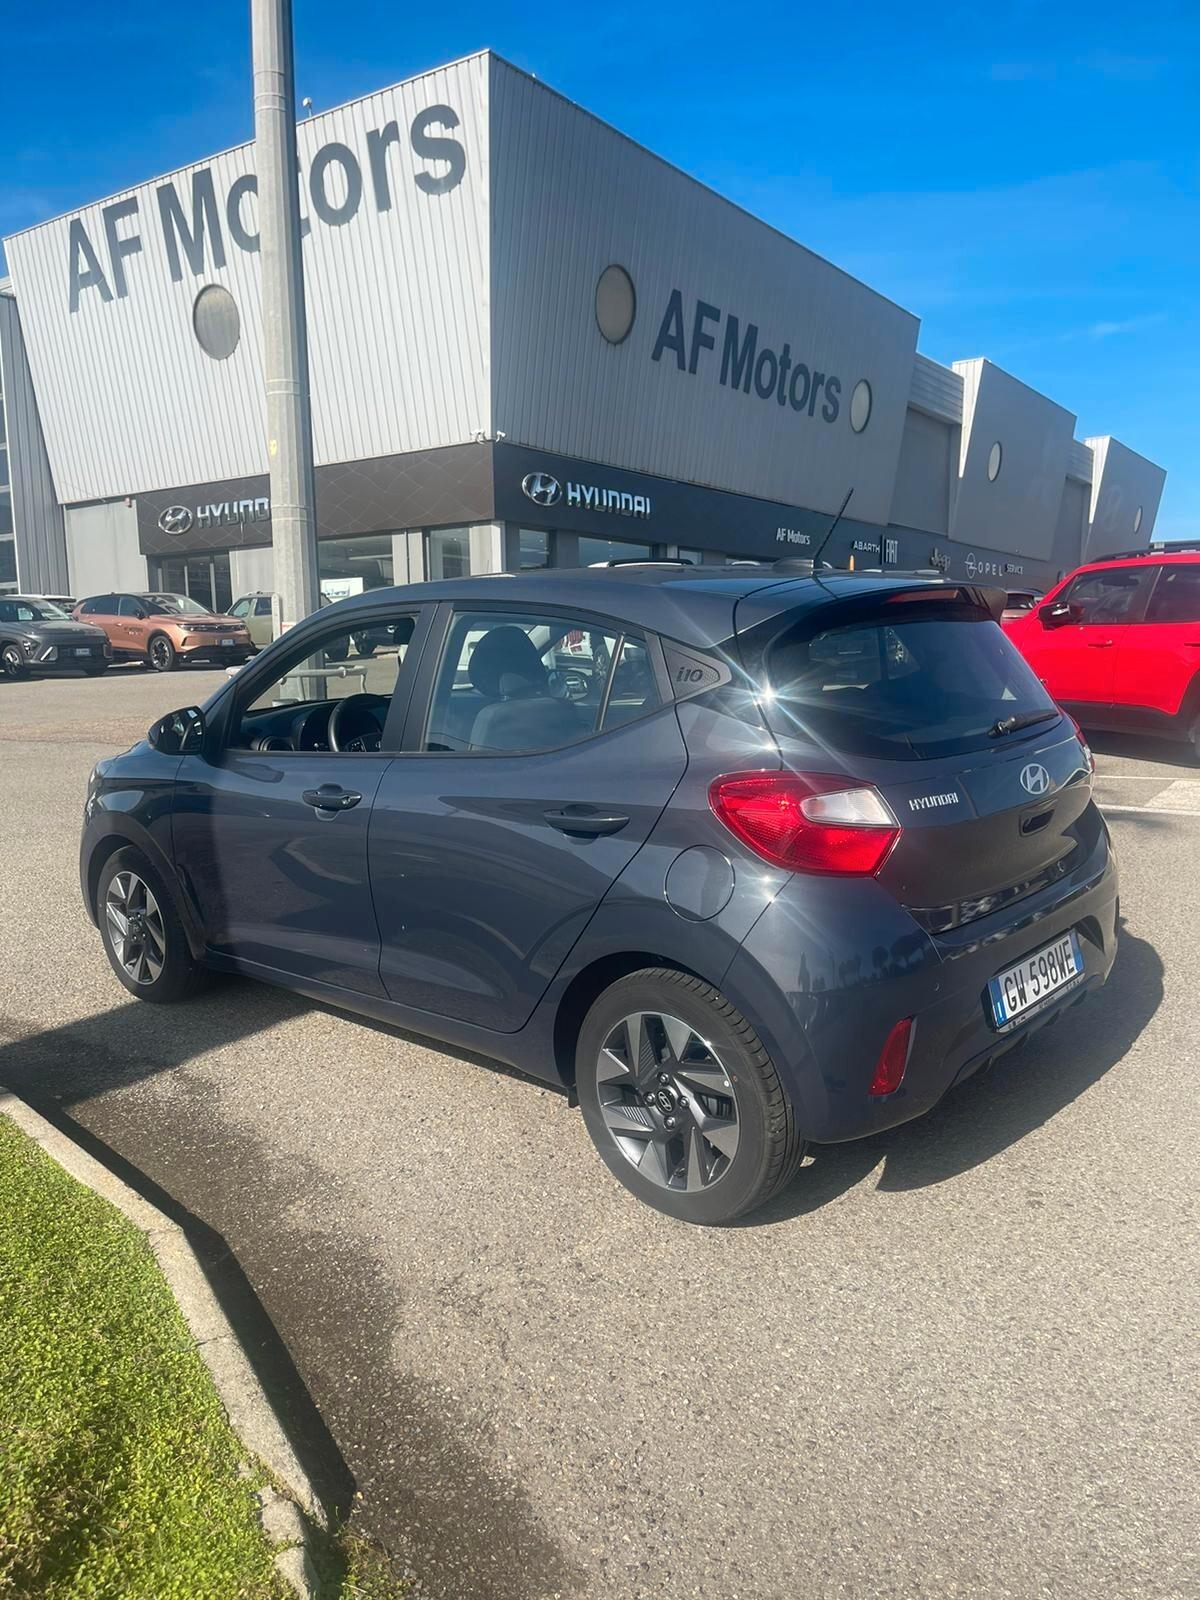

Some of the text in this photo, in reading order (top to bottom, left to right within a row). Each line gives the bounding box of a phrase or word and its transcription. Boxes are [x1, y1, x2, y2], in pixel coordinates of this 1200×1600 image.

[68, 103, 466, 313] AF Moors
[651, 287, 842, 424] AF Motors
[197, 497, 271, 529] HYUND
[567, 481, 651, 520] HYUNDAI
[776, 527, 811, 545] AF Motors
[853, 540, 880, 554] ABARTH
[885, 539, 898, 564] FIAT
[978, 561, 1003, 577] OPEL
[677, 666, 703, 683] i10
[909, 792, 959, 811] HYUNDAI
[1004, 969, 1028, 1012] GW
[1029, 940, 1075, 997] 598WE
